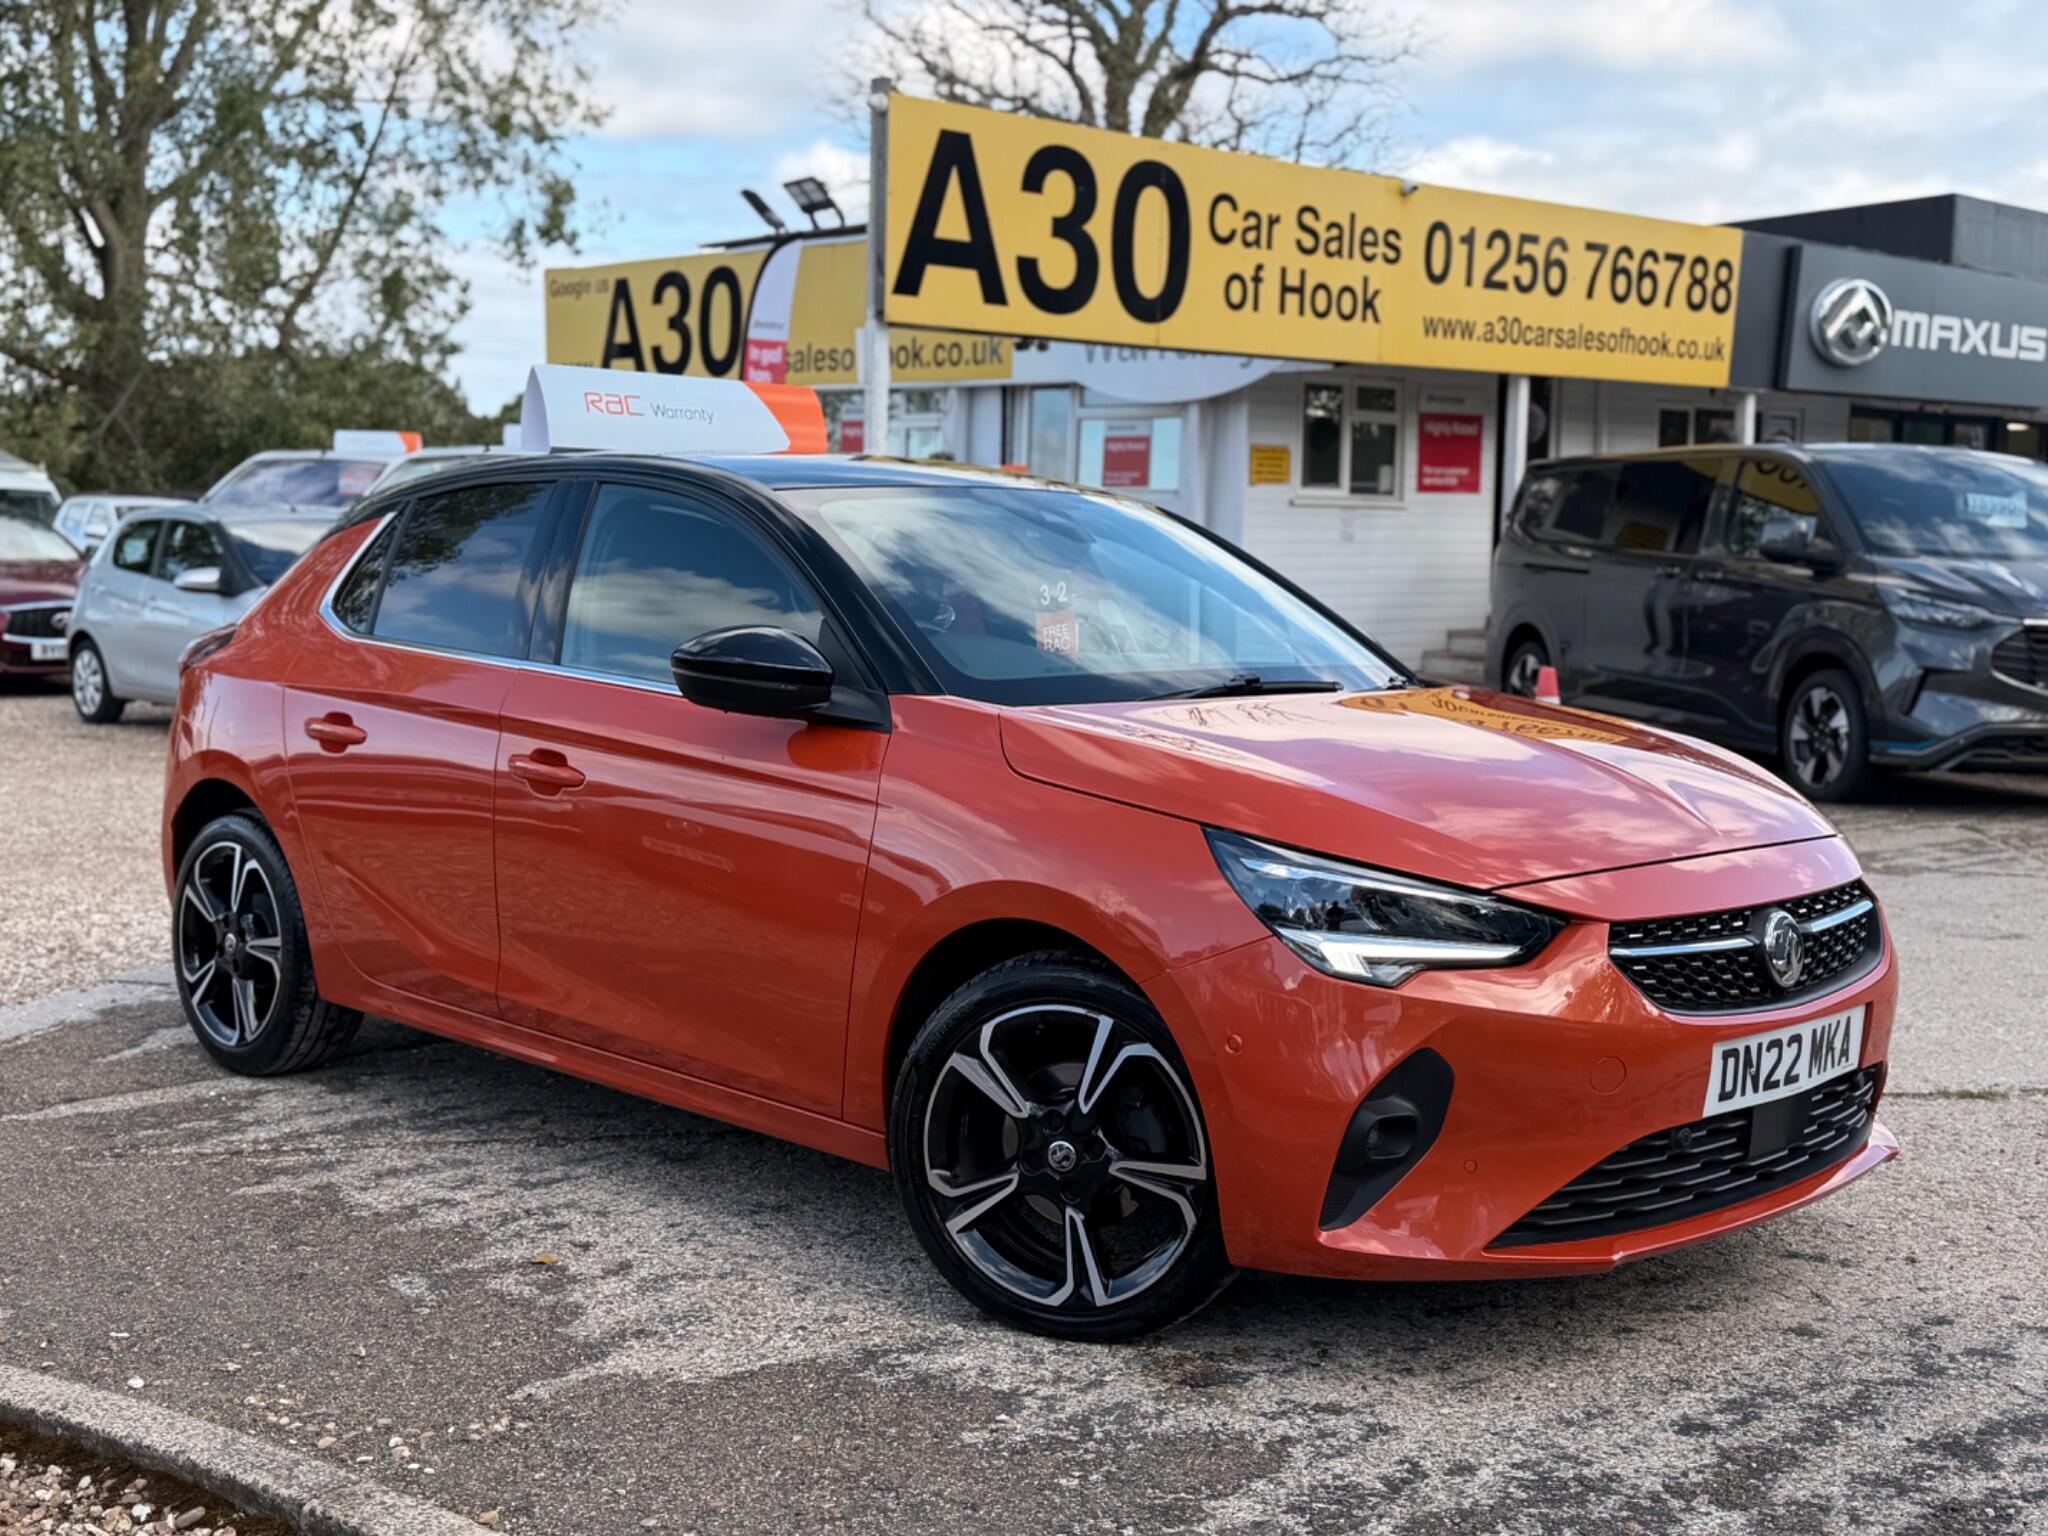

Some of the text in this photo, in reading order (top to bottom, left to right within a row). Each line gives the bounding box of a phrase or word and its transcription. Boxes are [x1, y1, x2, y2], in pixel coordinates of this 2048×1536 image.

[892, 129, 1190, 324] A30
[1208, 193, 1402, 265] Car Sales
[1224, 263, 1381, 324] of Hook
[1424, 220, 1735, 314] 01256 766788
[601, 265, 742, 378] A30
[1422, 315, 1726, 361] www.a30carsalesofhook.co.uk
[1890, 309, 2048, 362] MAXUS
[650, 403, 714, 425] Warranty
[1718, 1016, 1851, 1102] DN22 MKA
